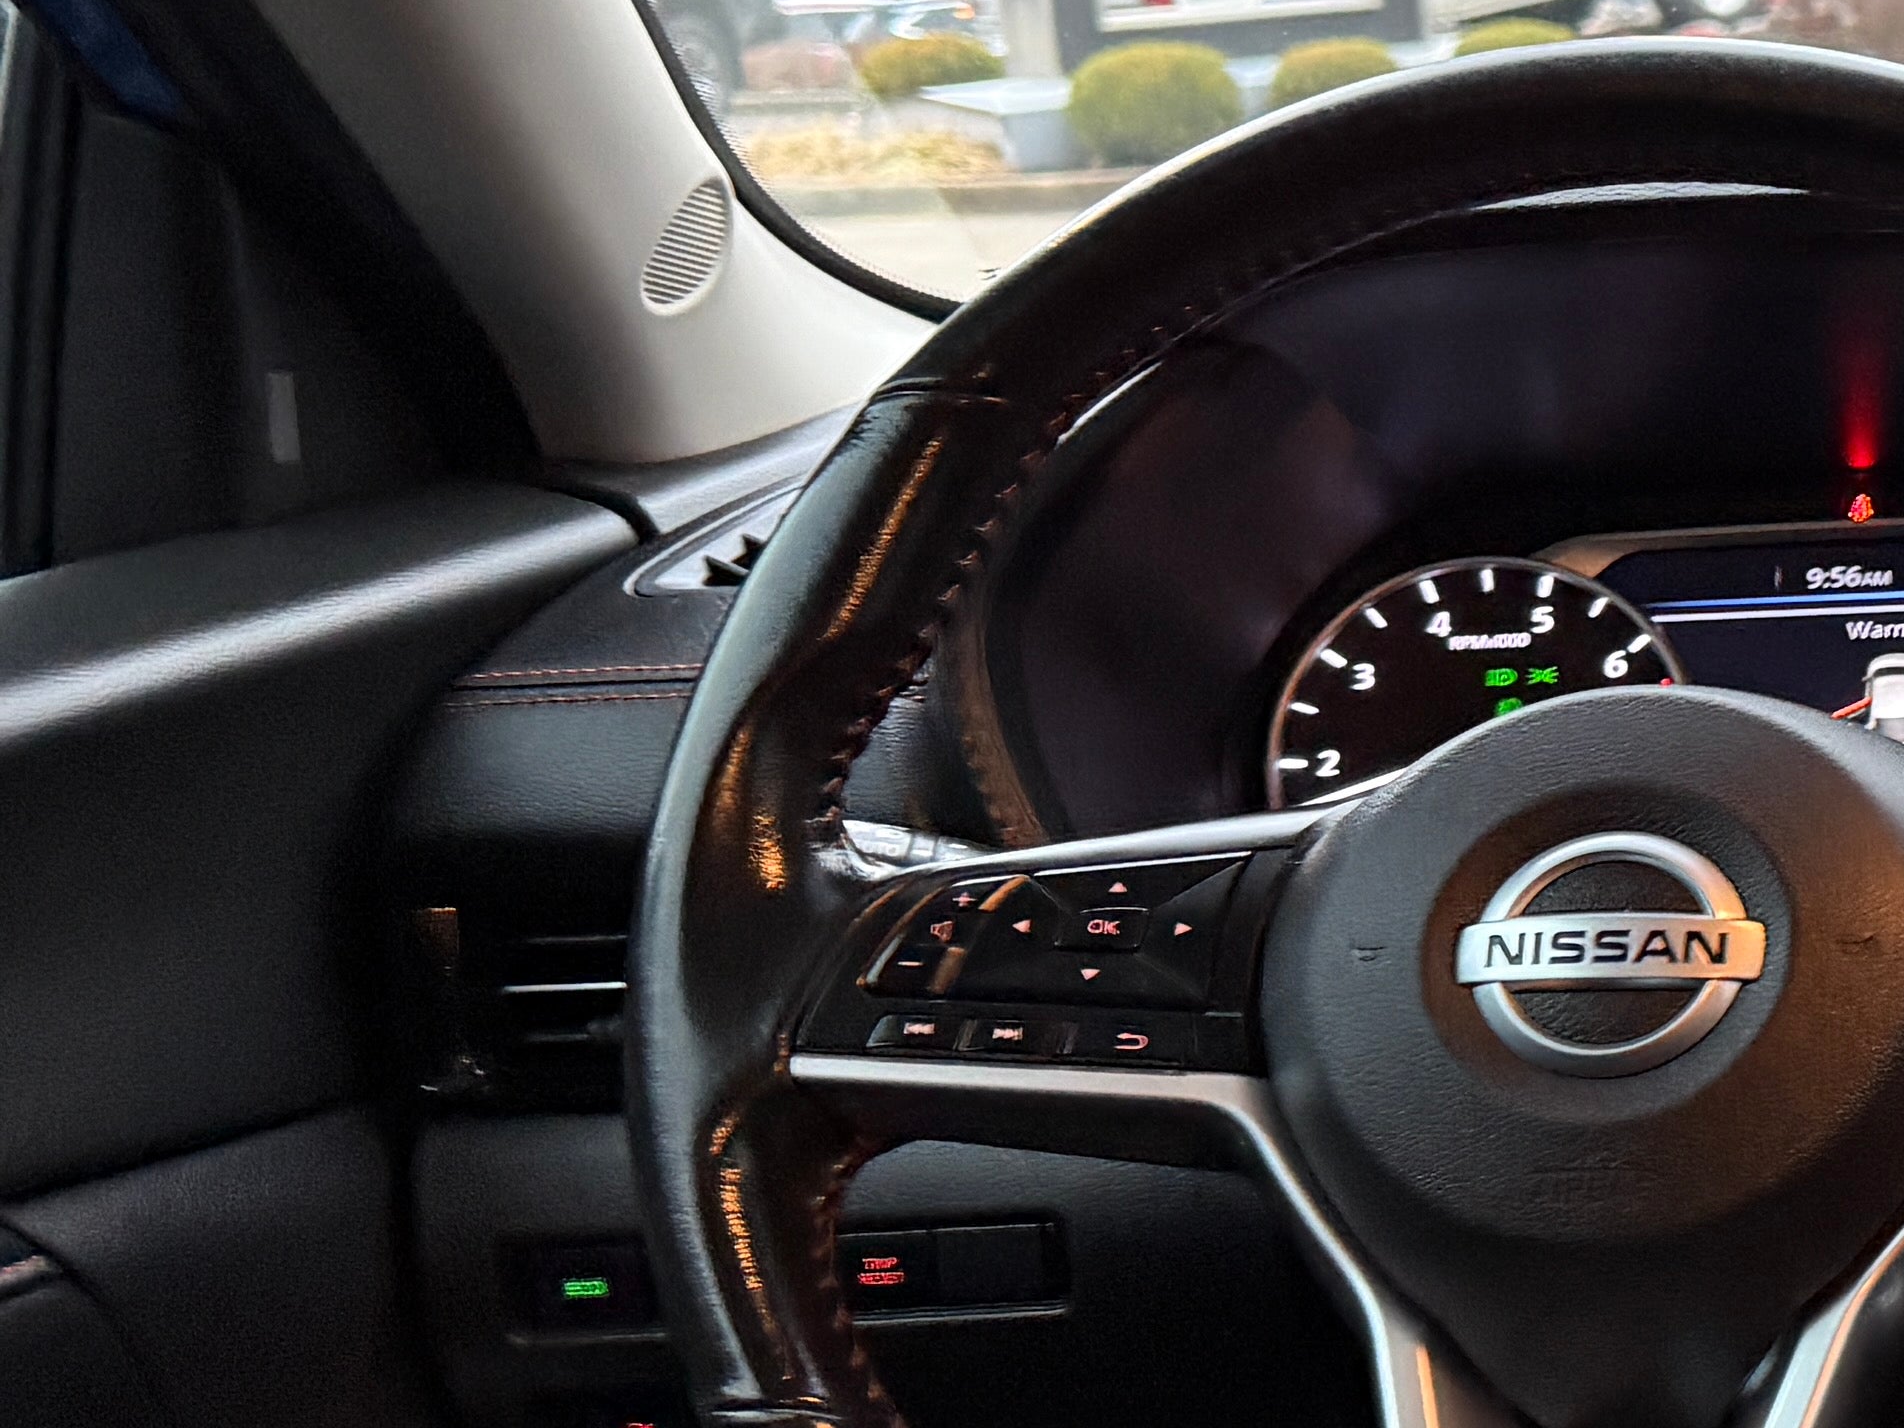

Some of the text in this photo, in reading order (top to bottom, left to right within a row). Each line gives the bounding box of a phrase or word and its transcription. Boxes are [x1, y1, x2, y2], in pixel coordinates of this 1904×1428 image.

[1425, 605, 1555, 637] 4 5
[1350, 662, 1377, 692] 3
[1602, 649, 1629, 679] 6
[1315, 749, 1342, 778] 2
[1086, 918, 1121, 938] OK
[1483, 928, 1729, 969] NISSAN
